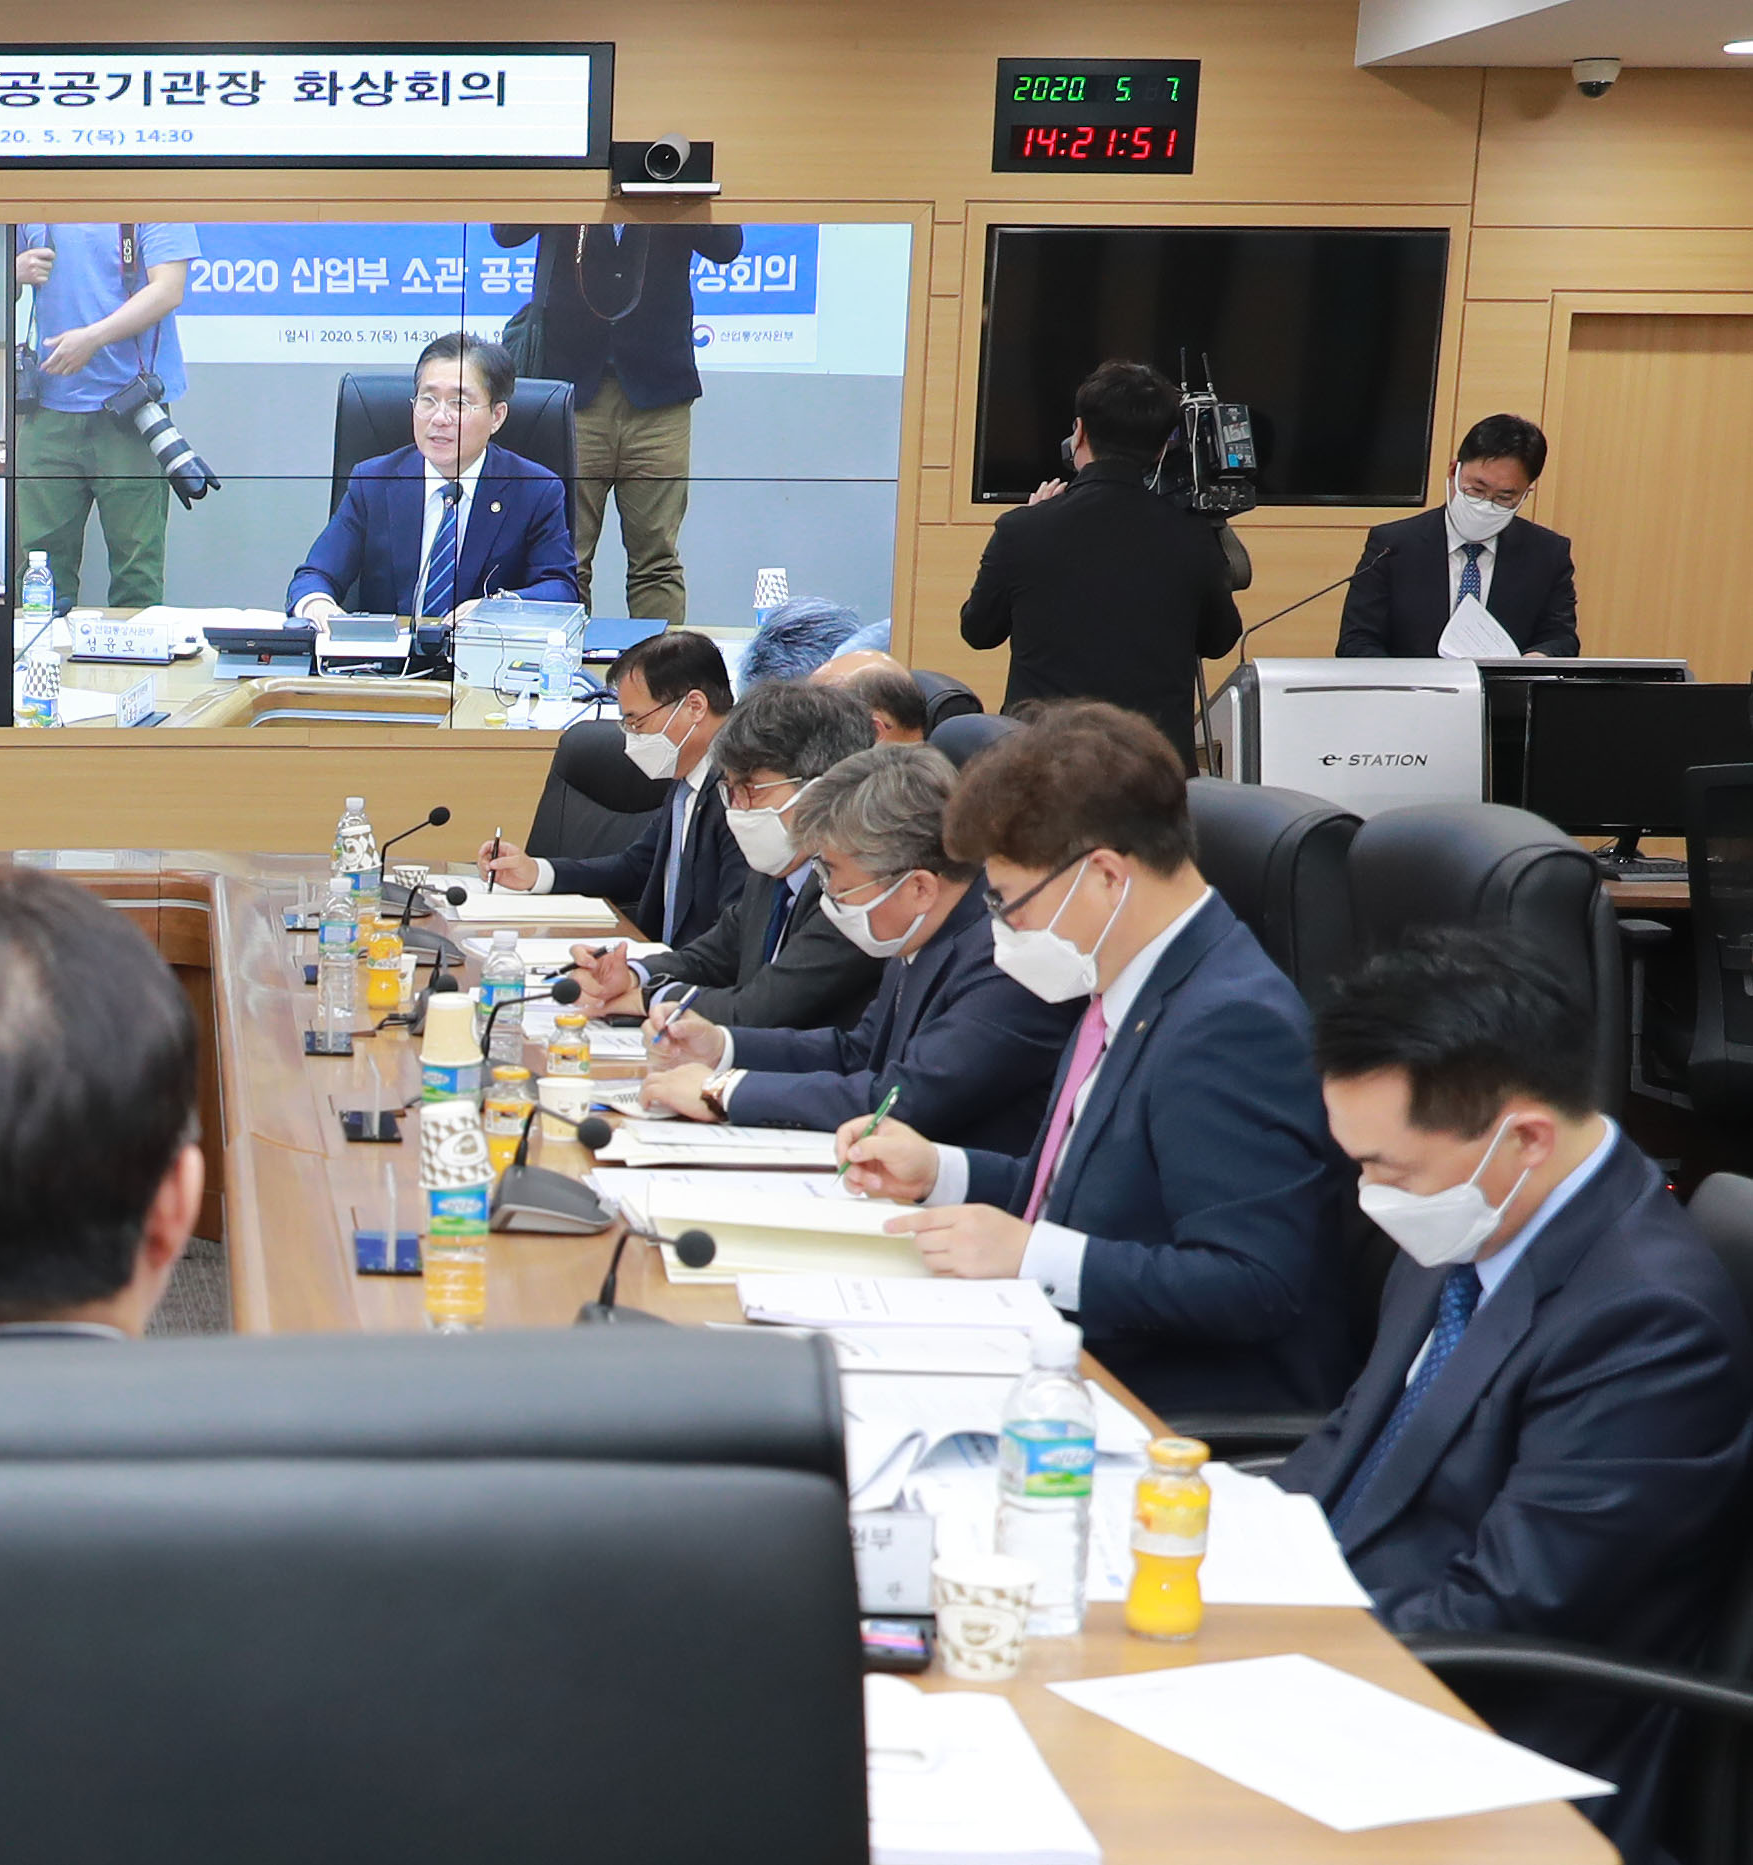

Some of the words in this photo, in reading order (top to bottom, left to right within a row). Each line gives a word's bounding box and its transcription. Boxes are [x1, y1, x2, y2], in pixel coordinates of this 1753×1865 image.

[292, 69, 507, 108] 화상회의
[42, 128, 62, 145] 5.
[70, 128, 126, 147] 7(목)
[135, 128, 194, 145] 14:30
[1022, 126, 1180, 160] 14:21:51
[122, 238, 133, 264] EOS
[190, 259, 279, 293] 2020
[291, 257, 390, 294] 산업부
[401, 257, 469, 295] 소관
[690, 254, 797, 293] 상회의
[403, 330, 439, 343] 14:30
[1348, 753, 1429, 767] STATION
